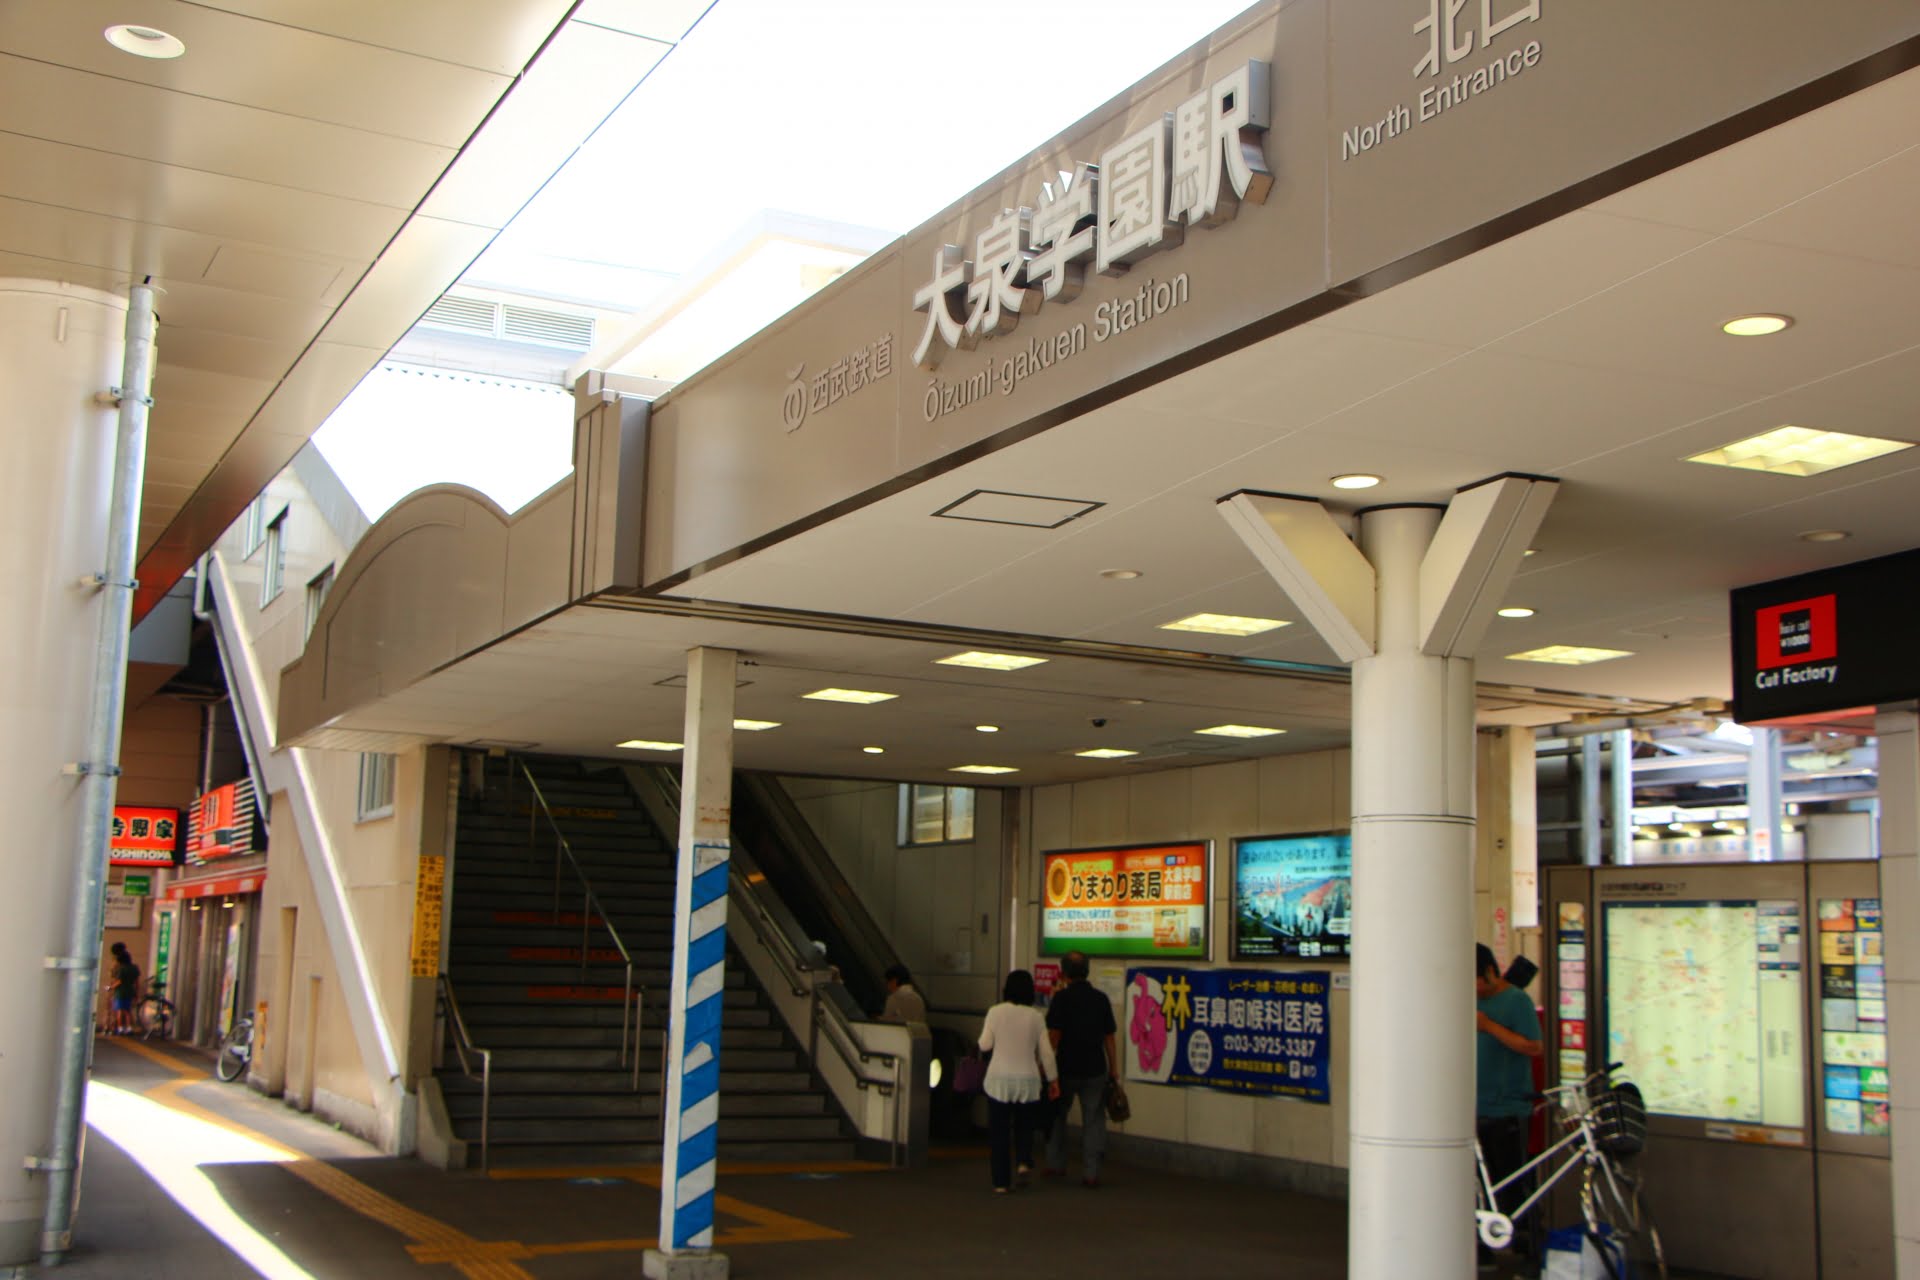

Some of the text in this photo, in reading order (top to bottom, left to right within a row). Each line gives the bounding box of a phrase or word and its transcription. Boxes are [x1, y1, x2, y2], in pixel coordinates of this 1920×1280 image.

[1342, 40, 1541, 161] North Entrance
[911, 61, 1262, 369] 大泉学園駅
[811, 332, 893, 415] 西武鉄道
[923, 272, 1189, 423] Ōizumi-gakuen Station
[1755, 665, 1838, 689] Cut Factory
[110, 849, 173, 861] OSHINOYA
[1071, 870, 1162, 900] ひまわり薬局
[1162, 975, 1191, 1031] 林
[1193, 996, 1324, 1034] 耳鼻咽喉科医院
